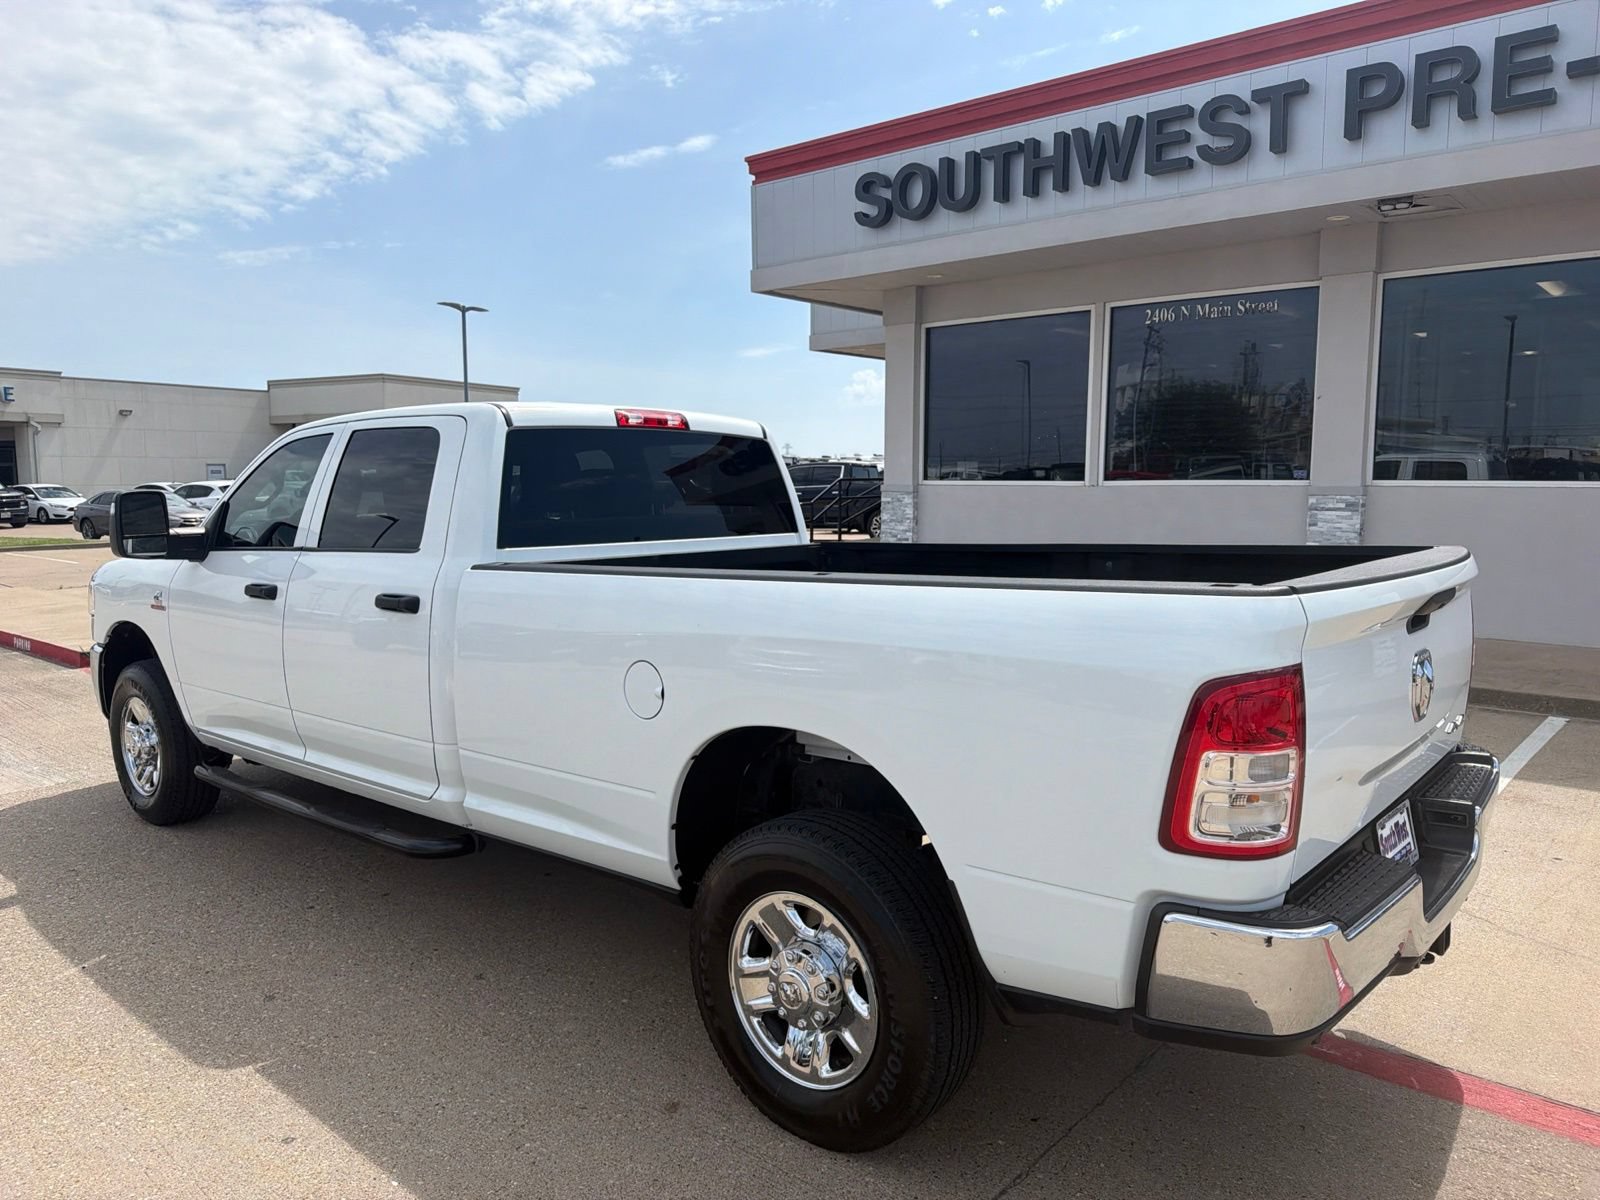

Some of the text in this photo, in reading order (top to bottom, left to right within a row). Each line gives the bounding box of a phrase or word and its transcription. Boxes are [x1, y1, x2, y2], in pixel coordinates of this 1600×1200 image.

[854, 78, 1310, 228] SOUTHWEST
[1144, 299, 1279, 325] 2406 N Main Street
